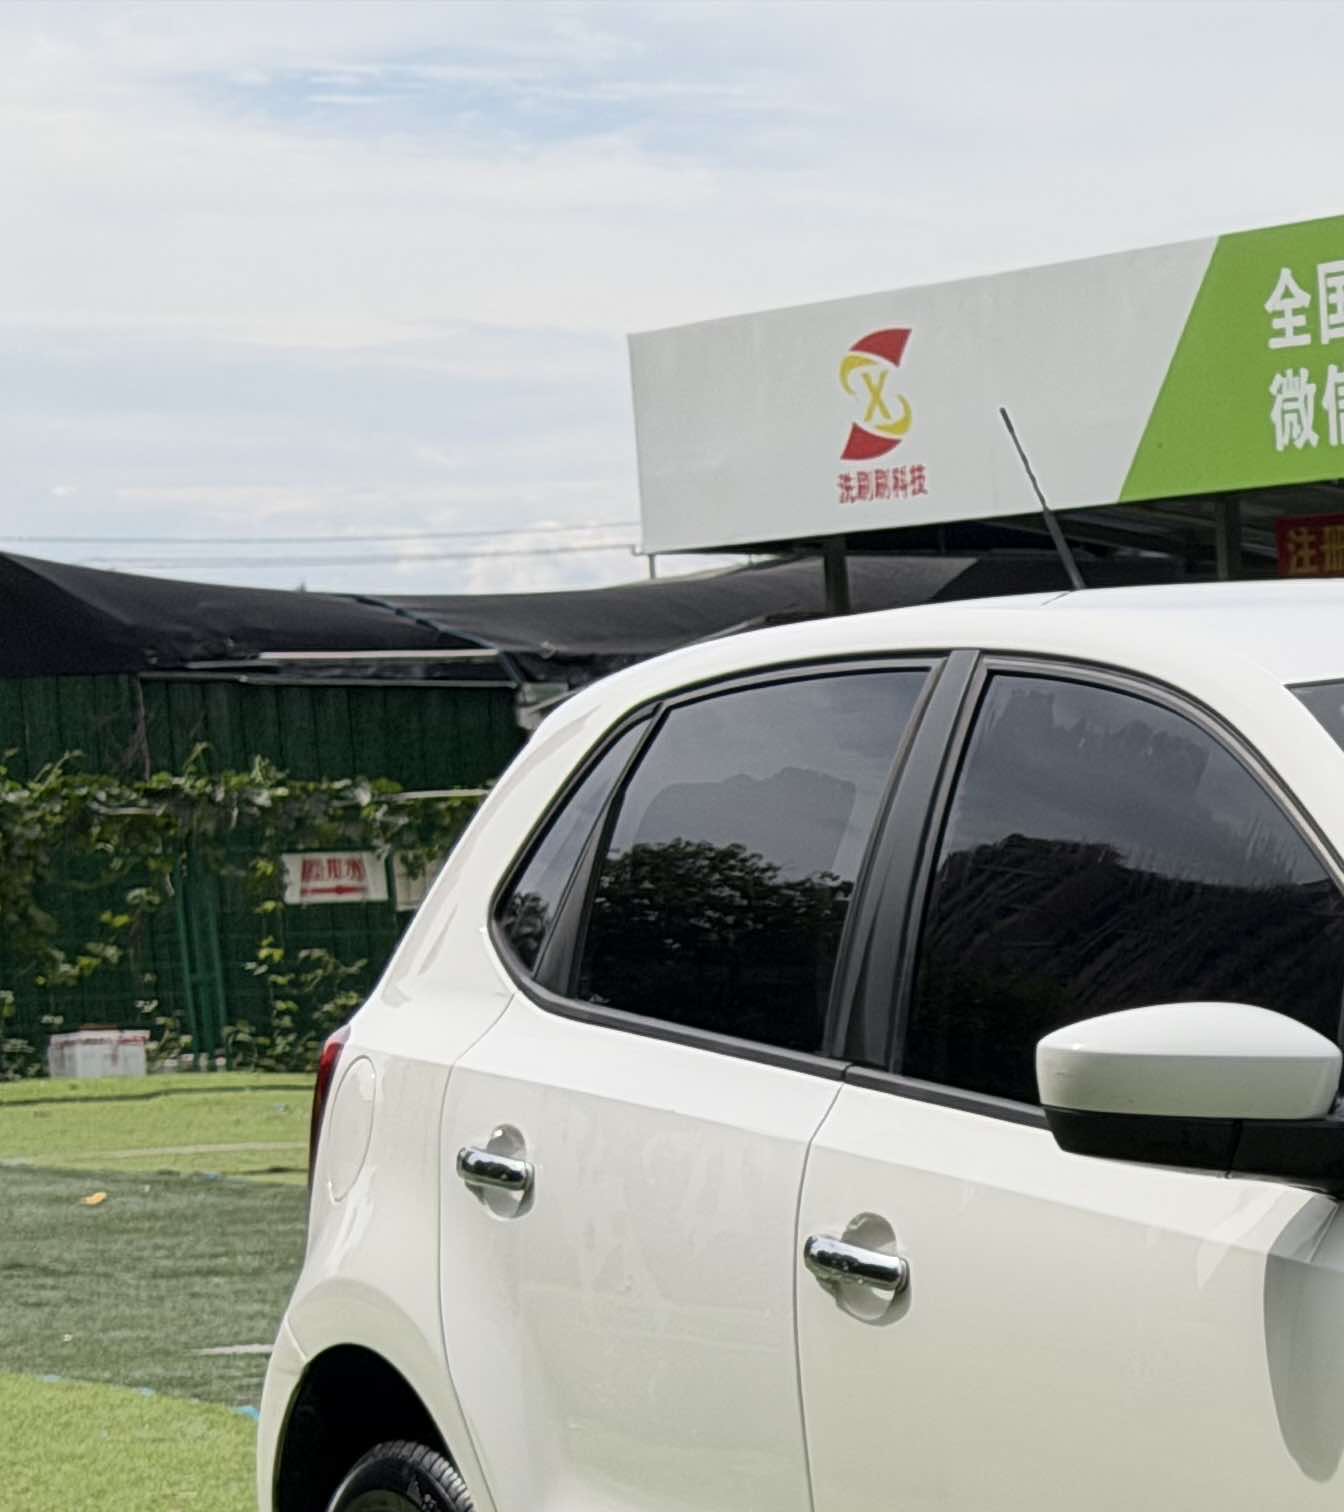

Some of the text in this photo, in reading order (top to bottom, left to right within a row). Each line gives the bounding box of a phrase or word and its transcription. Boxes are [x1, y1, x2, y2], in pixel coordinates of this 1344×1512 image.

[837, 464, 928, 504] 洗刷刷科技
